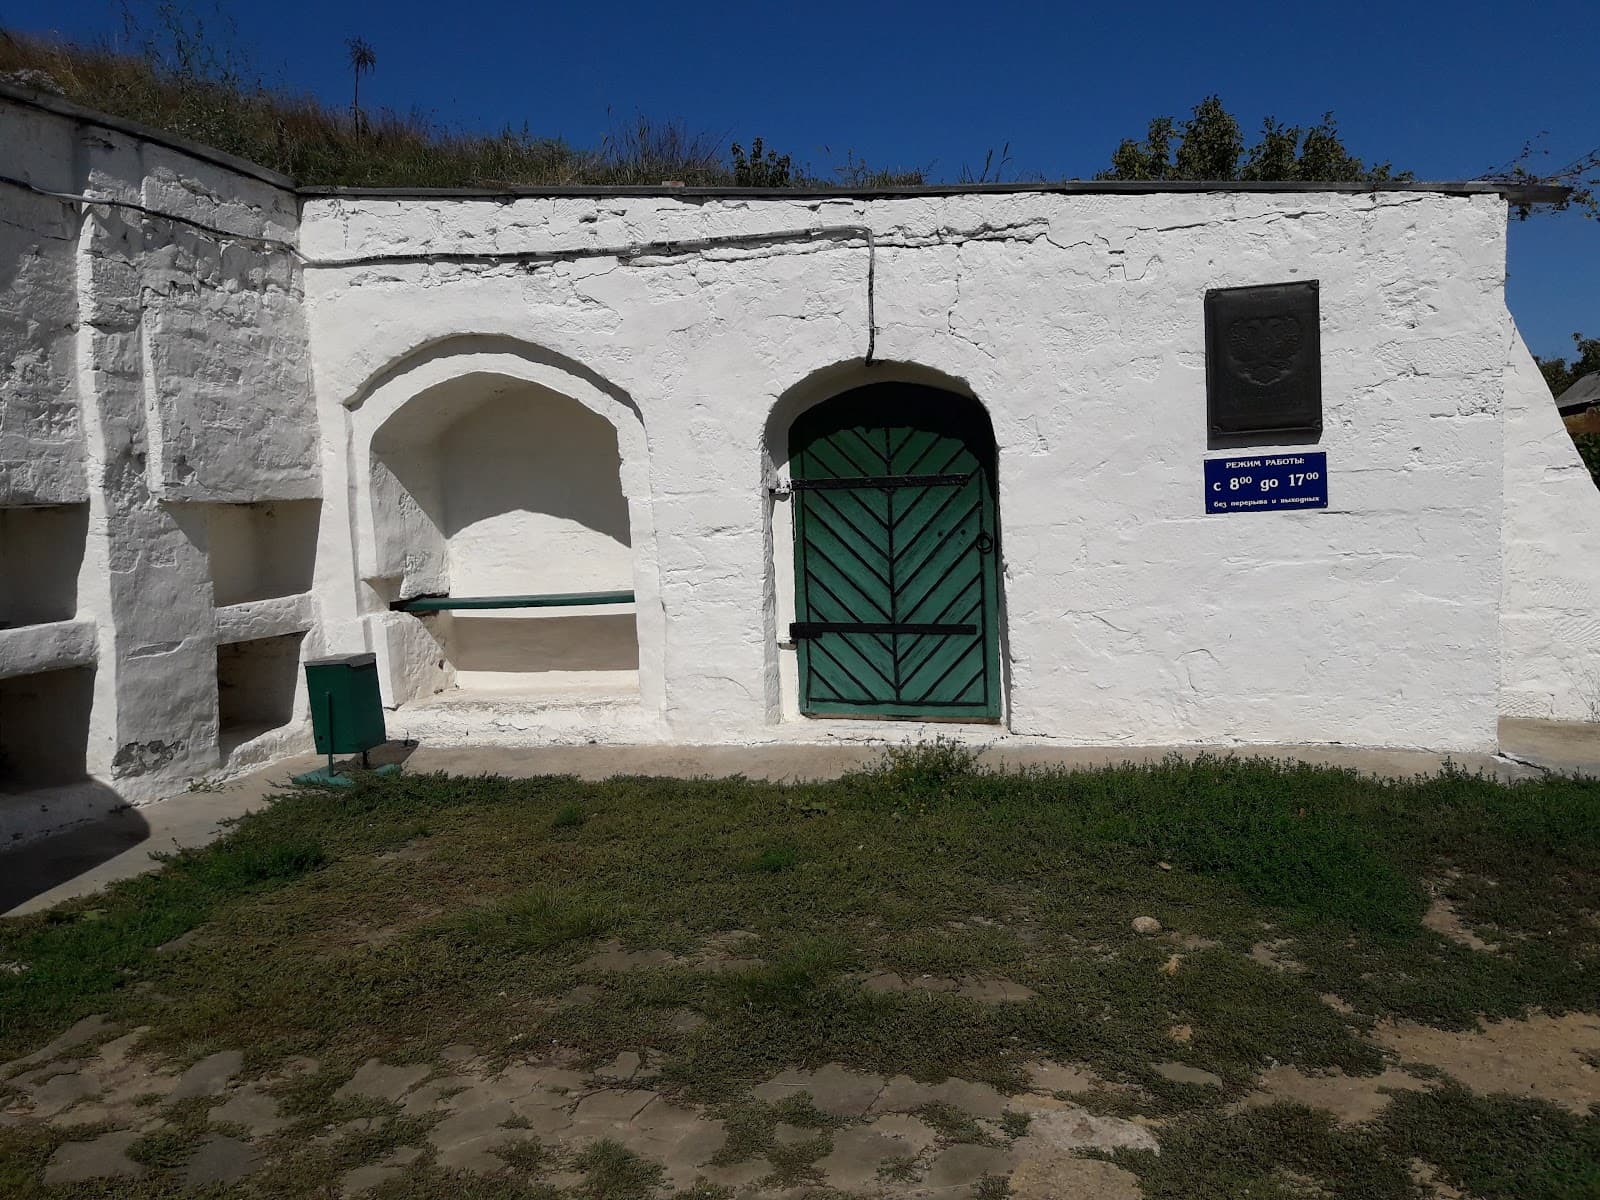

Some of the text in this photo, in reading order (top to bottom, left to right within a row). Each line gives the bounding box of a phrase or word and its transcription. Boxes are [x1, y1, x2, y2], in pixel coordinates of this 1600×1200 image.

[1225, 457, 1305, 469] РЕЖИМ РАБОТЫ:
[1213, 482, 1222, 491] с
[1260, 478, 1279, 492] до
[1213, 500, 1227, 508] без
[1230, 499, 1268, 507] перерыва
[1280, 496, 1320, 504] выходных
